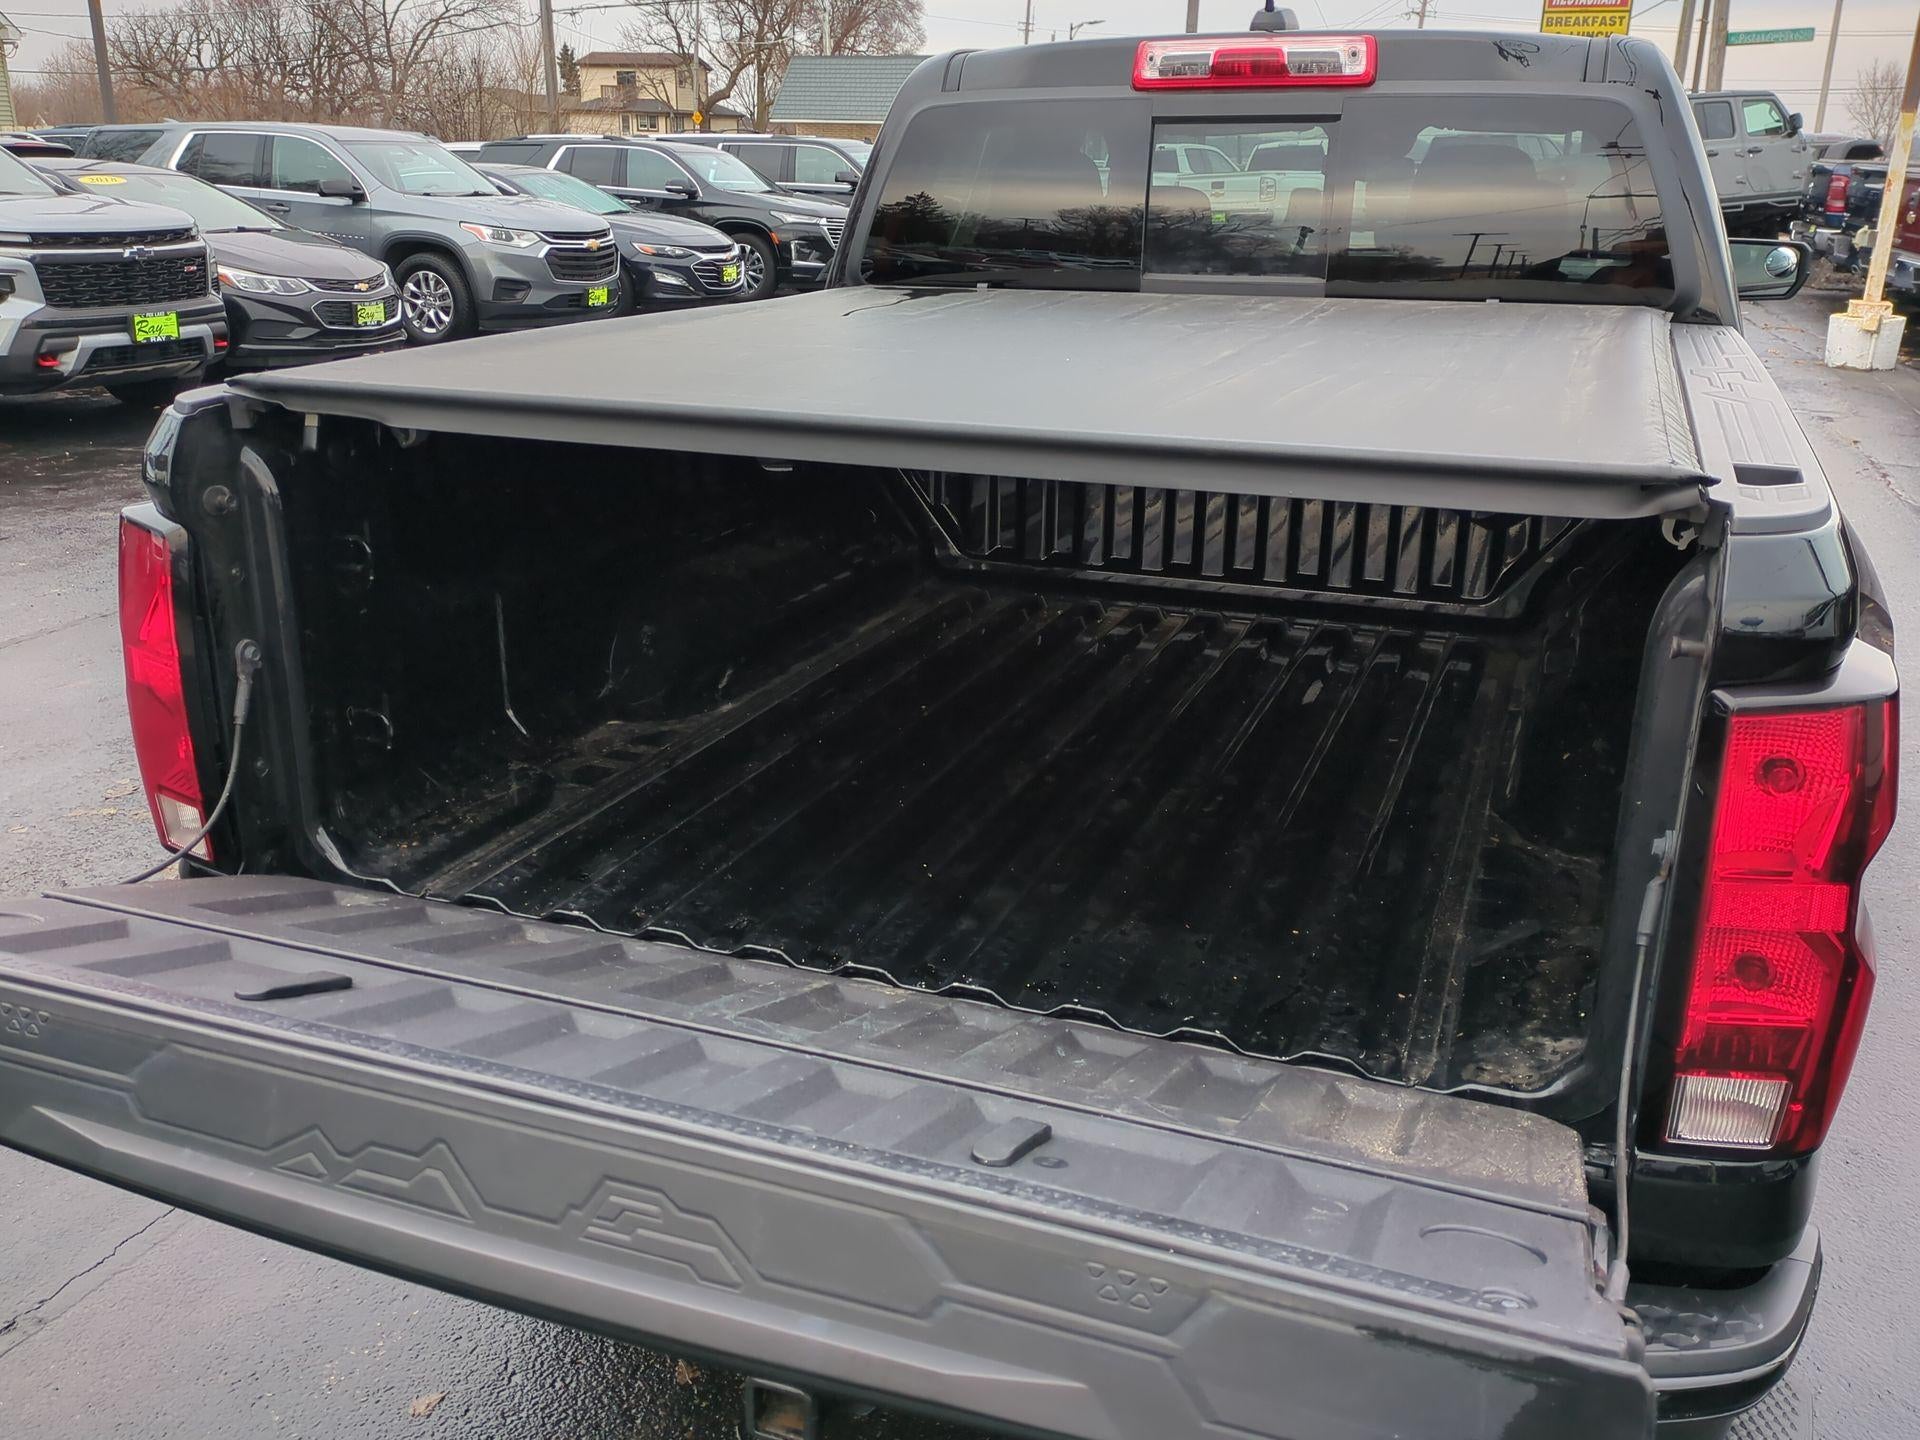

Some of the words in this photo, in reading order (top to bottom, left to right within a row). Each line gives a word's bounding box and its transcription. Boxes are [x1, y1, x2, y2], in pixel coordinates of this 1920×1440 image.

[1545, 15, 1626, 27] BREAKFAST
[357, 308, 375, 320] Ray
[136, 319, 164, 336] Ray
